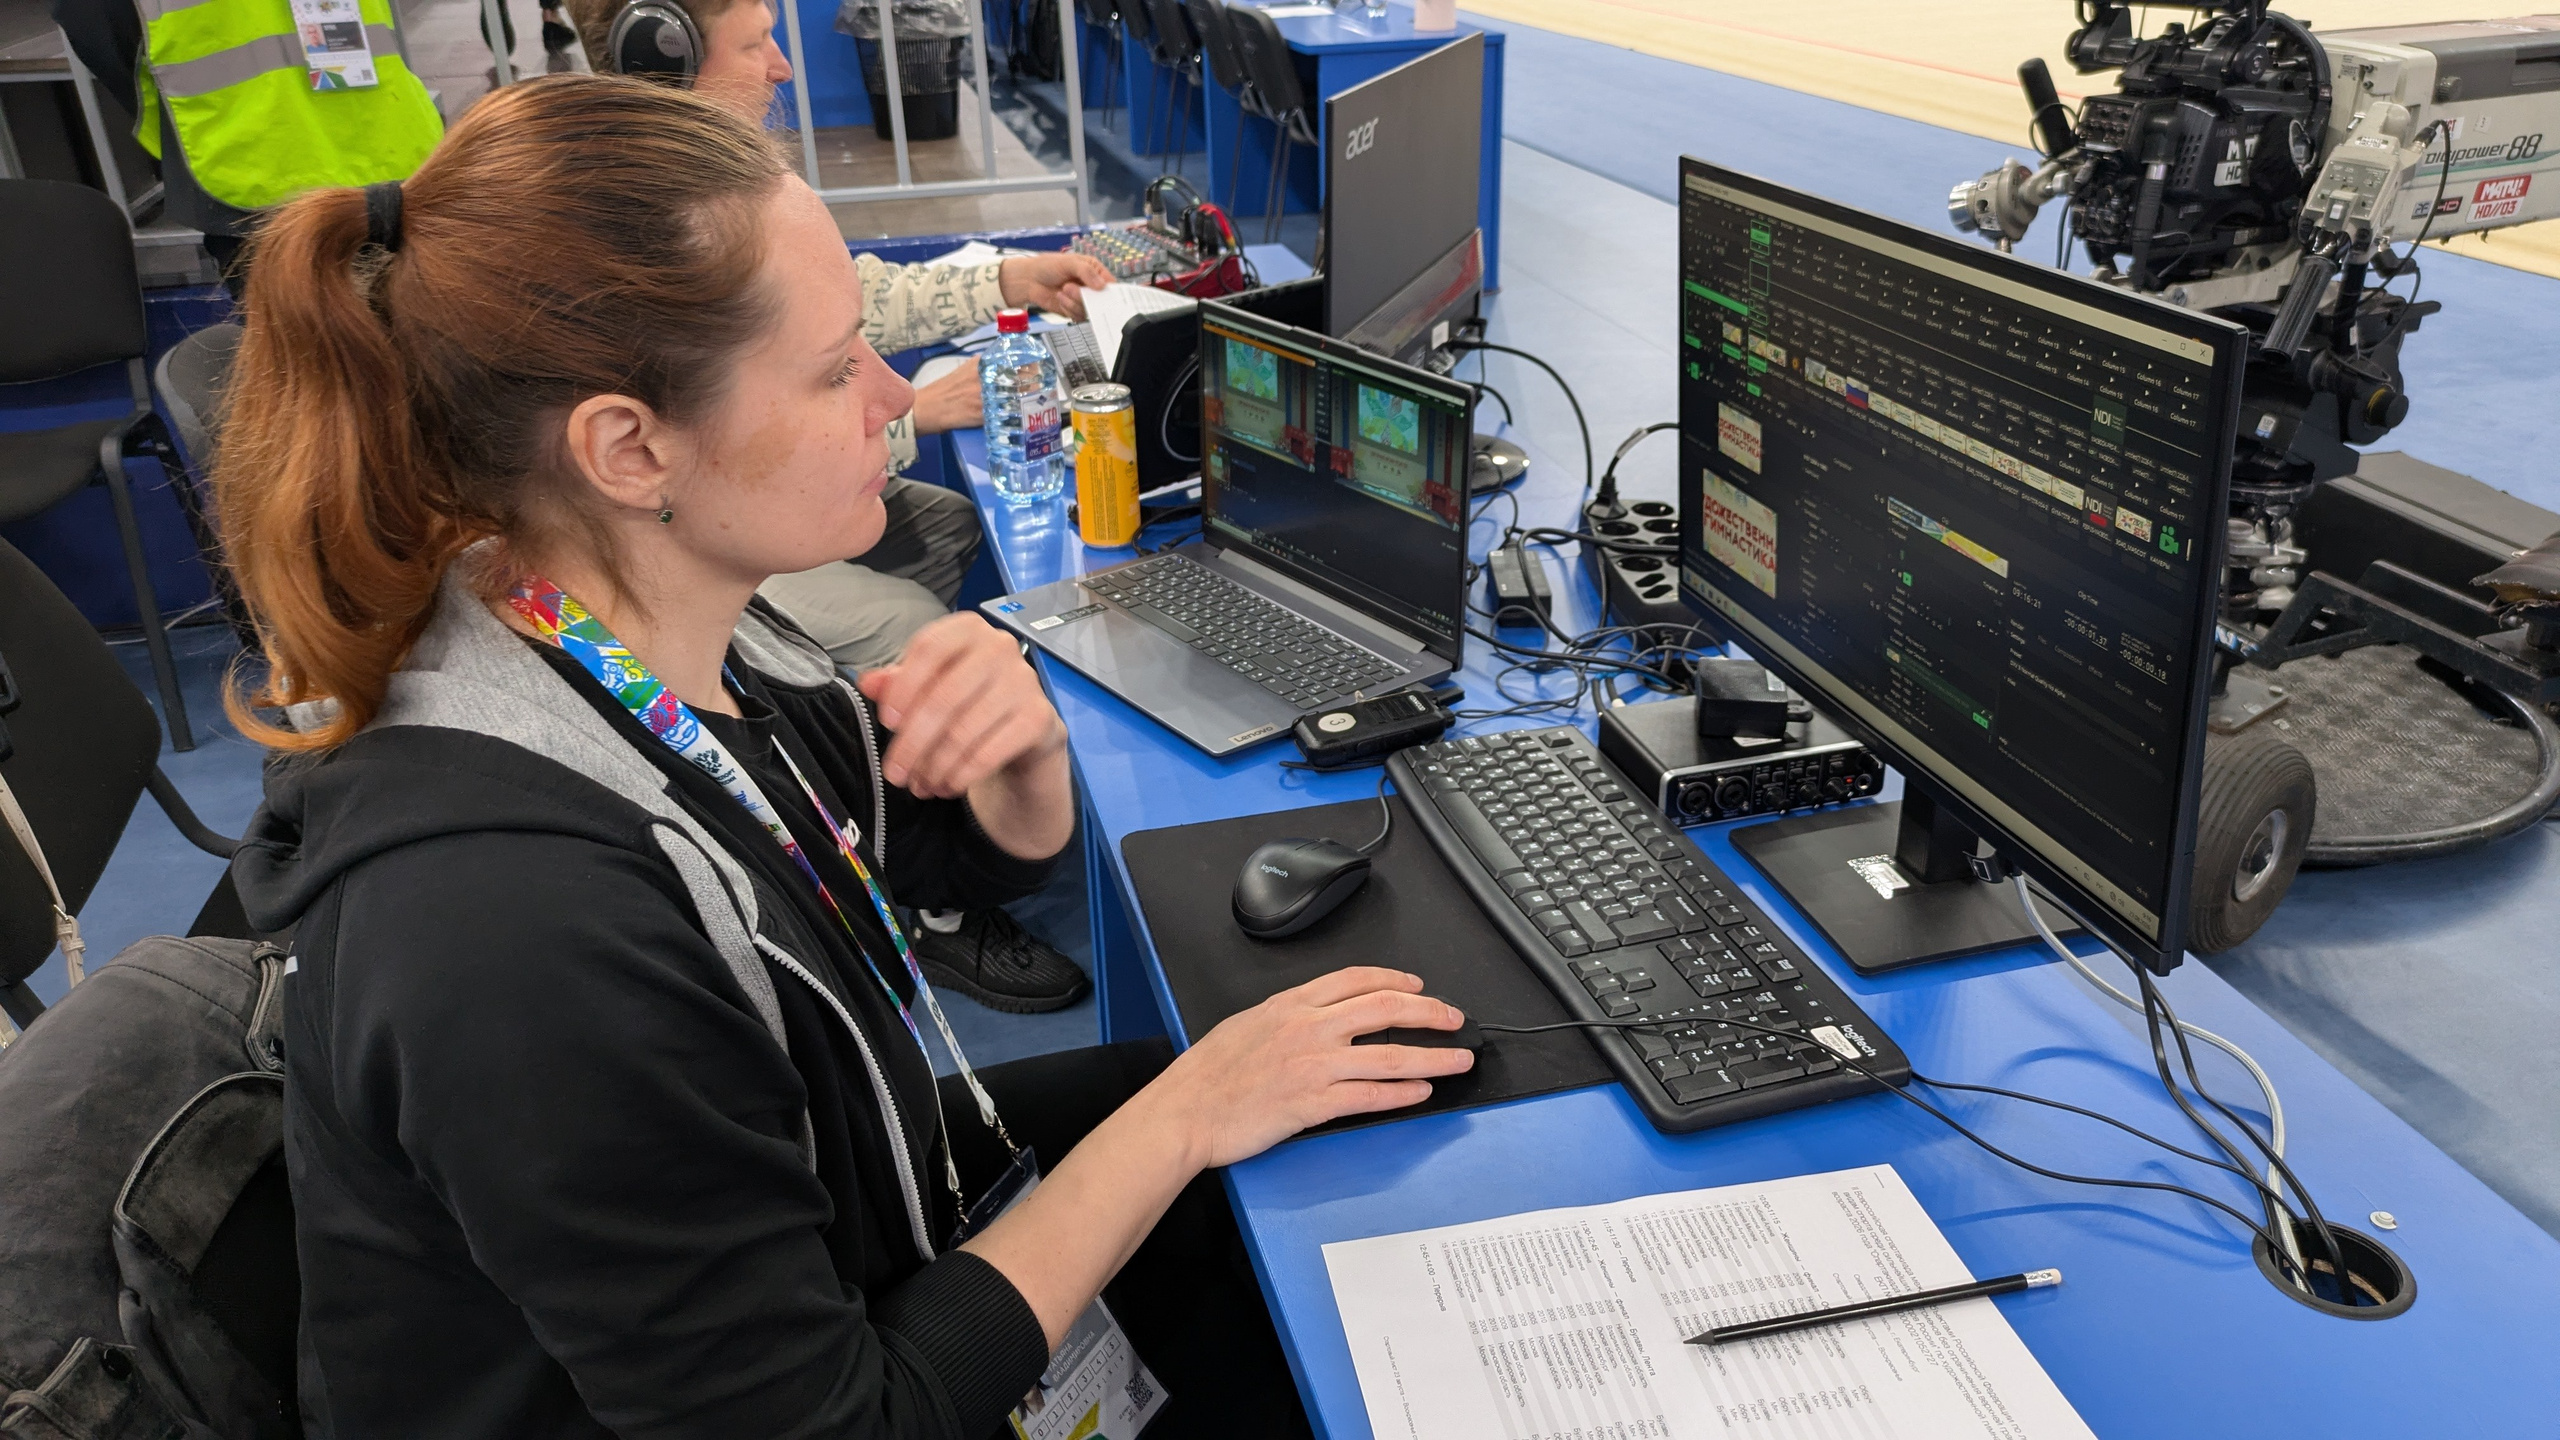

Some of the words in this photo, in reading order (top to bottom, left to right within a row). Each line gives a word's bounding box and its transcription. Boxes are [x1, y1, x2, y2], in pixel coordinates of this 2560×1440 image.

[1346, 117, 1378, 160] acer
[2506, 134, 2543, 161] 88
[2474, 201, 2518, 220] HD//03
[2101, 358, 2117, 373] Column
[2118, 364, 2125, 376] 15
[2136, 370, 2153, 386] Column
[2153, 377, 2161, 389] 16
[2099, 384, 2115, 398] Column
[2116, 390, 2122, 401] 15
[2173, 384, 2190, 400] Column
[2191, 390, 2199, 403] 17
[2094, 408, 2111, 427] NDI
[2133, 397, 2150, 412] Column
[2151, 404, 2158, 415] 16
[2169, 411, 2187, 426] Column
[2187, 418, 2196, 430] 17
[1718, 429, 1761, 458] ГИМНАСТИКА
[2090, 472, 2106, 488] Column
[2085, 496, 2103, 514] NDI
[2124, 488, 2141, 504] Column
[2159, 503, 2177, 520] Column
[1703, 512, 1776, 574] ГИМНАСТИКА
[2012, 587, 2041, 609] 09:16:21
[2078, 590, 2087, 601] Clip
[2087, 595, 2098, 606] Time
[2064, 618, 2108, 645] -00:00:01.37
[2119, 650, 2167, 680] -00:00:00.18
[1234, 725, 1273, 743] Lenovo
[1261, 863, 1289, 878] logitech
[1841, 1024, 1877, 1057] logitech
[1718, 1070, 1731, 1082] Enter
[1829, 1191, 1854, 1217] возраста
[1847, 1217, 1865, 1233] 2026
[1857, 1233, 1874, 1249] года
[1851, 1190, 1891, 1235] Всероссийская
[1881, 1236, 1916, 1275] спартакиада
[1601, 1218, 1621, 1248] 11:15-11:30
[1618, 1256, 1638, 1283] Перерыв
[1756, 1194, 1782, 1224] 10:00-11:15
[1777, 1232, 1804, 1261] Женщины
[1801, 1271, 1821, 1292] финал
[1841, 1191, 1859, 1209] видам
[1853, 1210, 1874, 1231] спорта
[1867, 1231, 1886, 1251] среди
[1879, 1251, 1914, 1292] сильнейших
[1418, 1243, 1436, 1275] 12:45-14:00
[1431, 1283, 1448, 1311] Перерыв
[1725, 1282, 1739, 1295] 2010
[1872, 1276, 1889, 1290] ЕКП
[1578, 1220, 1599, 1251] 11:30-12:45
[1596, 1258, 1616, 1288] Женщины
[1613, 1298, 1631, 1319] финал
[1628, 1328, 1647, 1354] Булавы,
[1641, 1355, 1658, 1376] Лента
[1478, 1319, 1489, 1333] 2006
[1507, 1314, 1518, 1328] 2009
[1536, 1309, 1547, 1323] 2010
[1565, 1304, 1577, 1318] 2000
[1575, 1329, 1599, 1371] Краснодарский
[1595, 1326, 1609, 1346] Омская
[1604, 1346, 1619, 1369] область
[1754, 1277, 1767, 1291] 2000
[1816, 1390, 1834, 1409] Обруч
[1773, 1274, 1786, 1288] 2009
[1836, 1386, 1855, 1408] Булавы
[1782, 1273, 1796, 1286] 2009
[1849, 1389, 1862, 1401] Мяч
[1791, 1272, 1804, 1285] 2009
[1829, 1337, 1847, 1358] область
[1855, 1384, 1875, 1403] Обруч
[1053, 1330, 1096, 1383] ВЛАДИМИРОВНА
[1603, 1299, 1615, 1312] 2009
[1633, 1365, 1650, 1388] область
[1654, 1414, 1671, 1437] Булавы
[1570, 1366, 1585, 1389] область
[1933, 1350, 1945, 1359] по
[1939, 1359, 1987, 1419] художественной
[1937, 1336, 1952, 1348] без
[1945, 1349, 1986, 1398] ограничения
[1976, 1395, 2005, 1425] верхней
[1950, 1338, 1988, 1380] Российской
[1979, 1381, 2017, 1423] Федерации
[2009, 1423, 2023, 1433] по
[1512, 1384, 1526, 1407] область
[1622, 1364, 1638, 1387] область
[1646, 1418, 1660, 1436] Лента
[1796, 1392, 1815, 1414] Булавы
[1828, 1390, 1843, 1407] Лента
[1037, 1428, 1044, 1437] 0
[1054, 1411, 1059, 1419] 1
